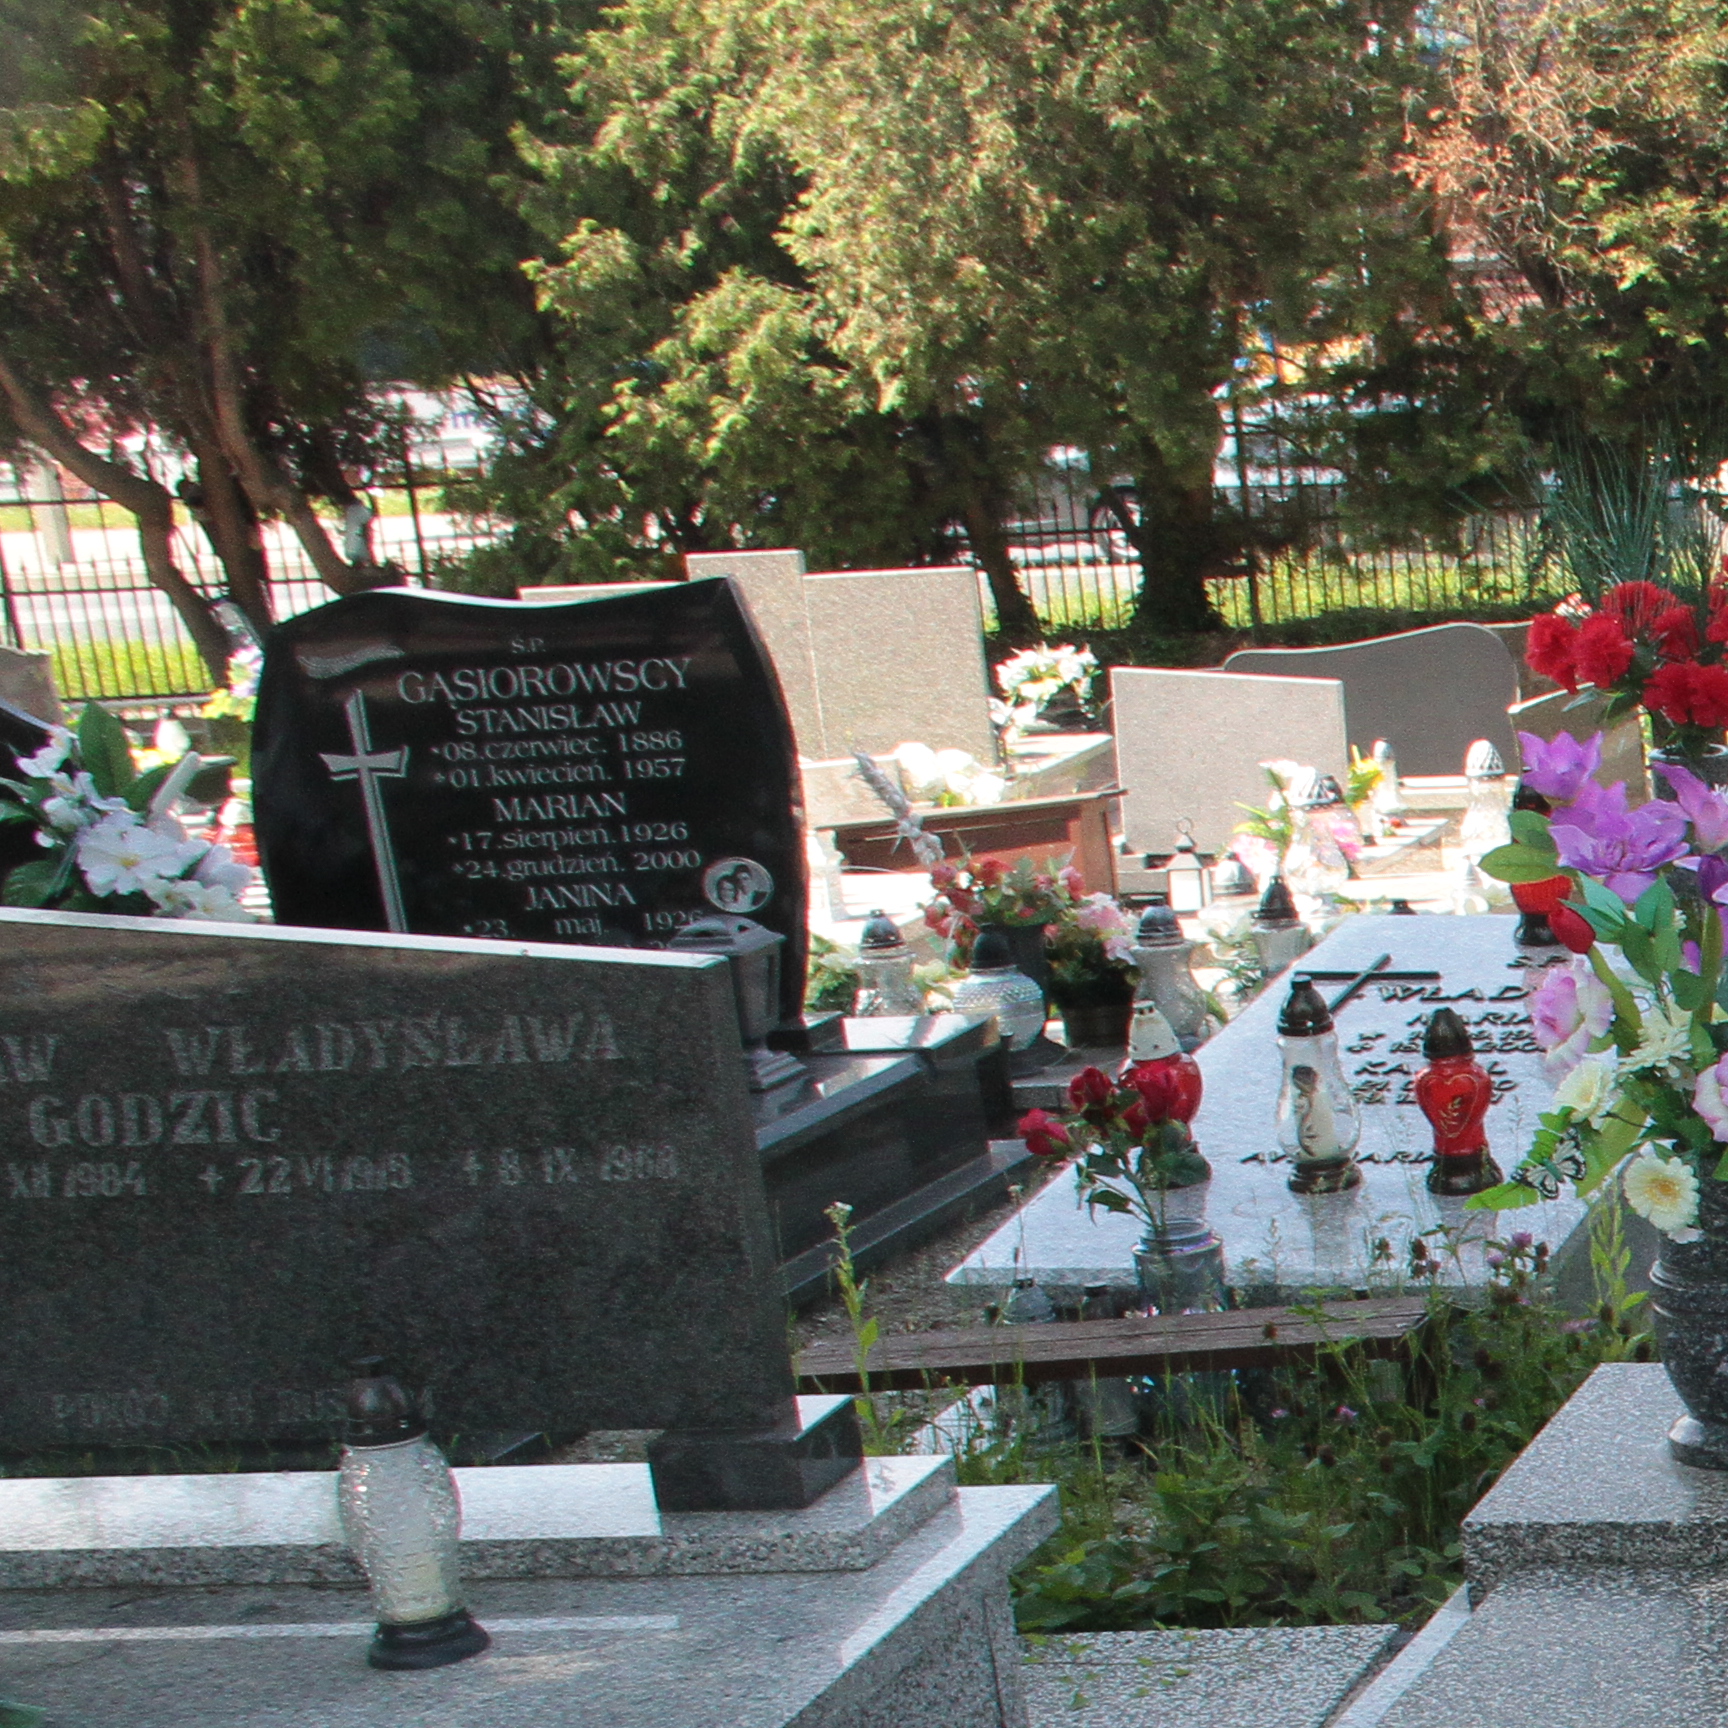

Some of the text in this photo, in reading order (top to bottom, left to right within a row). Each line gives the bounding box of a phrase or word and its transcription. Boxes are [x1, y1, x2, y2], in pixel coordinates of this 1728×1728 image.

[397, 657, 692, 709] GĄSIOROWSCY
[456, 701, 641, 736] STANISŁAW
[618, 730, 684, 753] 1886
[623, 758, 686, 779] 1957
[492, 791, 627, 822] MARIAN
[633, 850, 701, 871] 2000
[524, 882, 637, 912] JANINA
